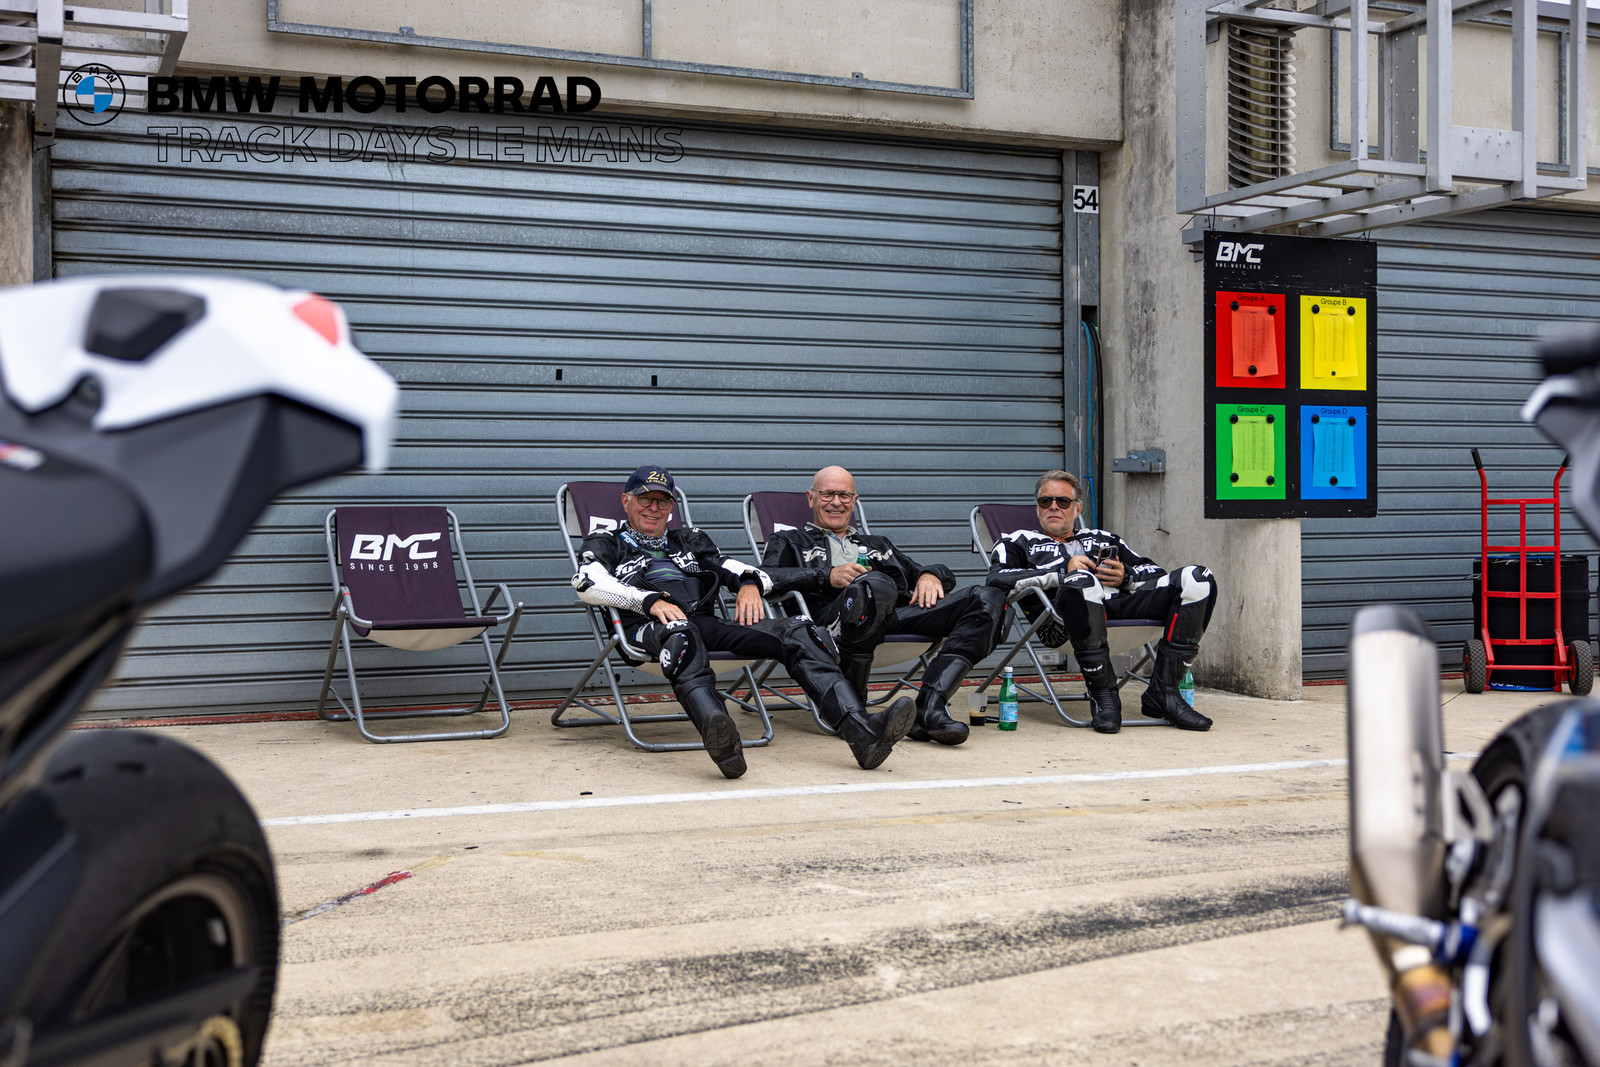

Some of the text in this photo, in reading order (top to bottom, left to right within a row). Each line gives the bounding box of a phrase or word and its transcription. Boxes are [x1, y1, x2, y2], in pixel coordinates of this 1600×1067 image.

[1073, 188, 1099, 211] 54
[1216, 241, 1264, 263] BMC
[1237, 294, 1259, 302] Groupe
[1320, 298, 1341, 306] Groupe
[1237, 405, 1259, 413] Groupe
[1320, 407, 1341, 415] Groupe
[350, 532, 441, 560] BMC
[350, 561, 438, 572] SINCE 1998
